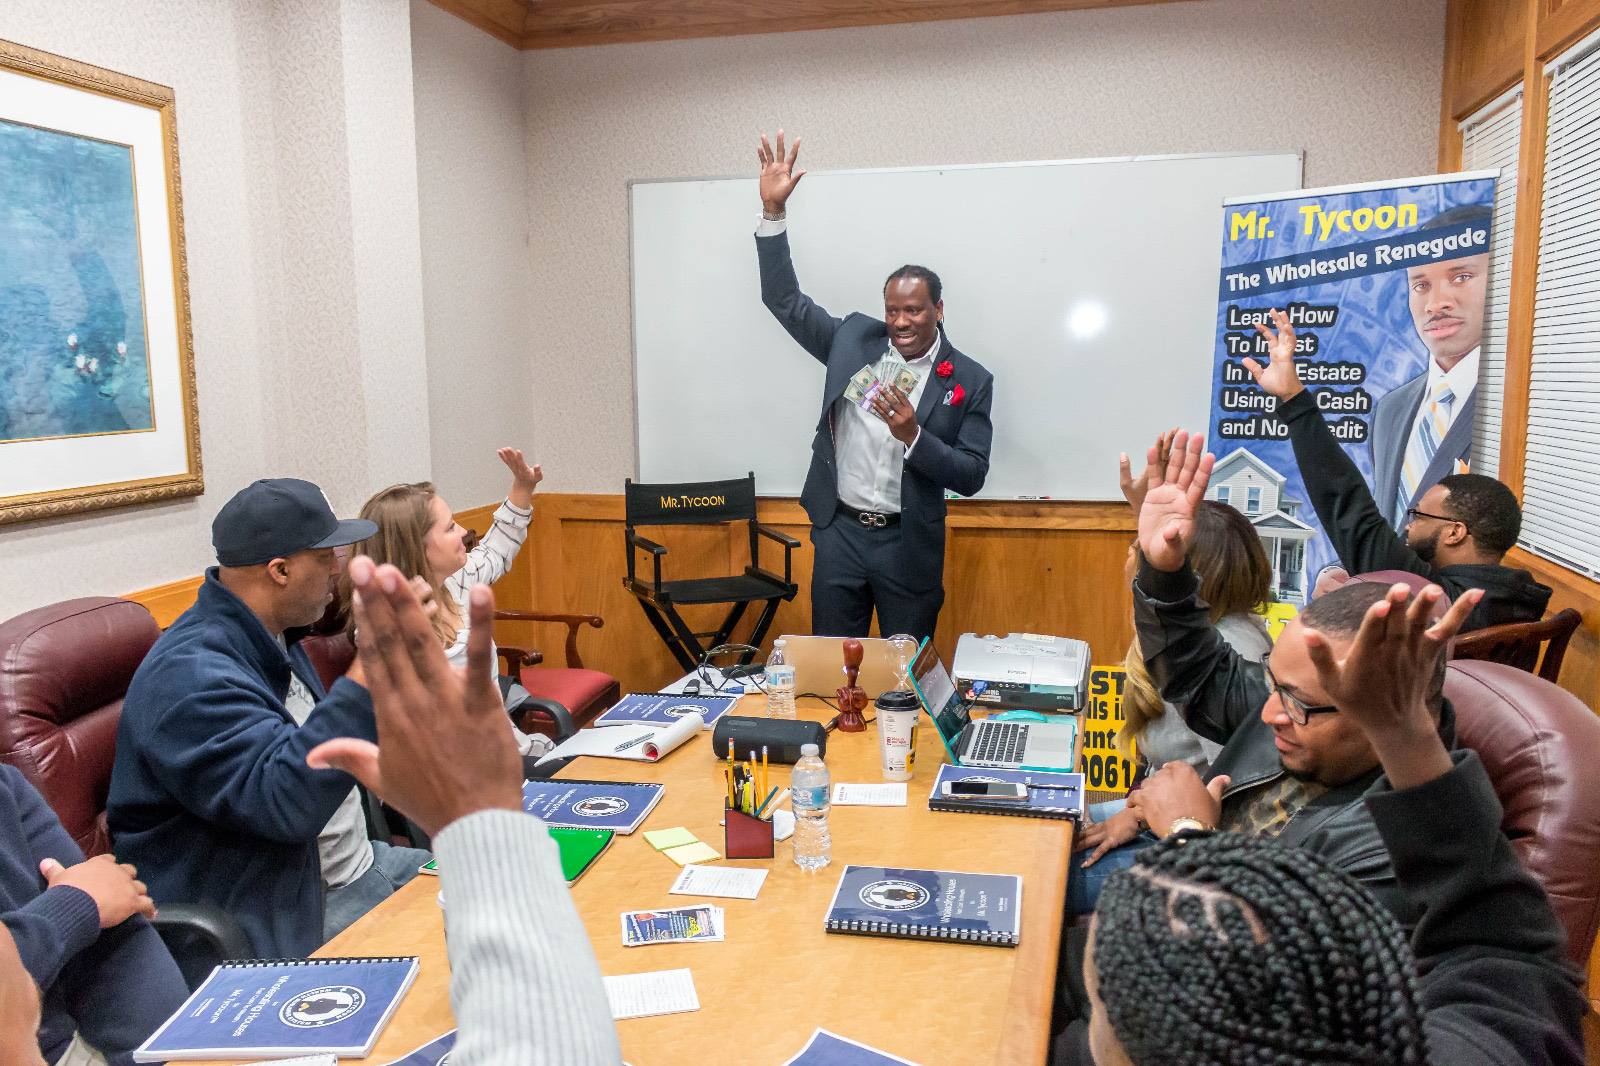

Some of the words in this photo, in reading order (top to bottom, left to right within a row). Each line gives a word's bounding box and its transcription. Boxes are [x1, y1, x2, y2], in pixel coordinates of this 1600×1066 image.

[1230, 212, 1275, 241] Mr.
[1299, 203, 1418, 242] Tycoon
[1226, 273, 1260, 291] The
[1265, 251, 1368, 284] Wholesale
[1375, 227, 1486, 265] Renegade
[1290, 306, 1334, 324] How
[1228, 336, 1250, 353] To
[1255, 336, 1314, 353] Inst
[1226, 364, 1242, 380] In
[1296, 363, 1361, 380] Estate
[1224, 391, 1276, 413] Using
[1316, 392, 1368, 410] Cash
[1222, 419, 1255, 436] and
[1261, 419, 1288, 436] No
[1087, 697, 1108, 720] ls
[231, 1012, 261, 1036] Houses
